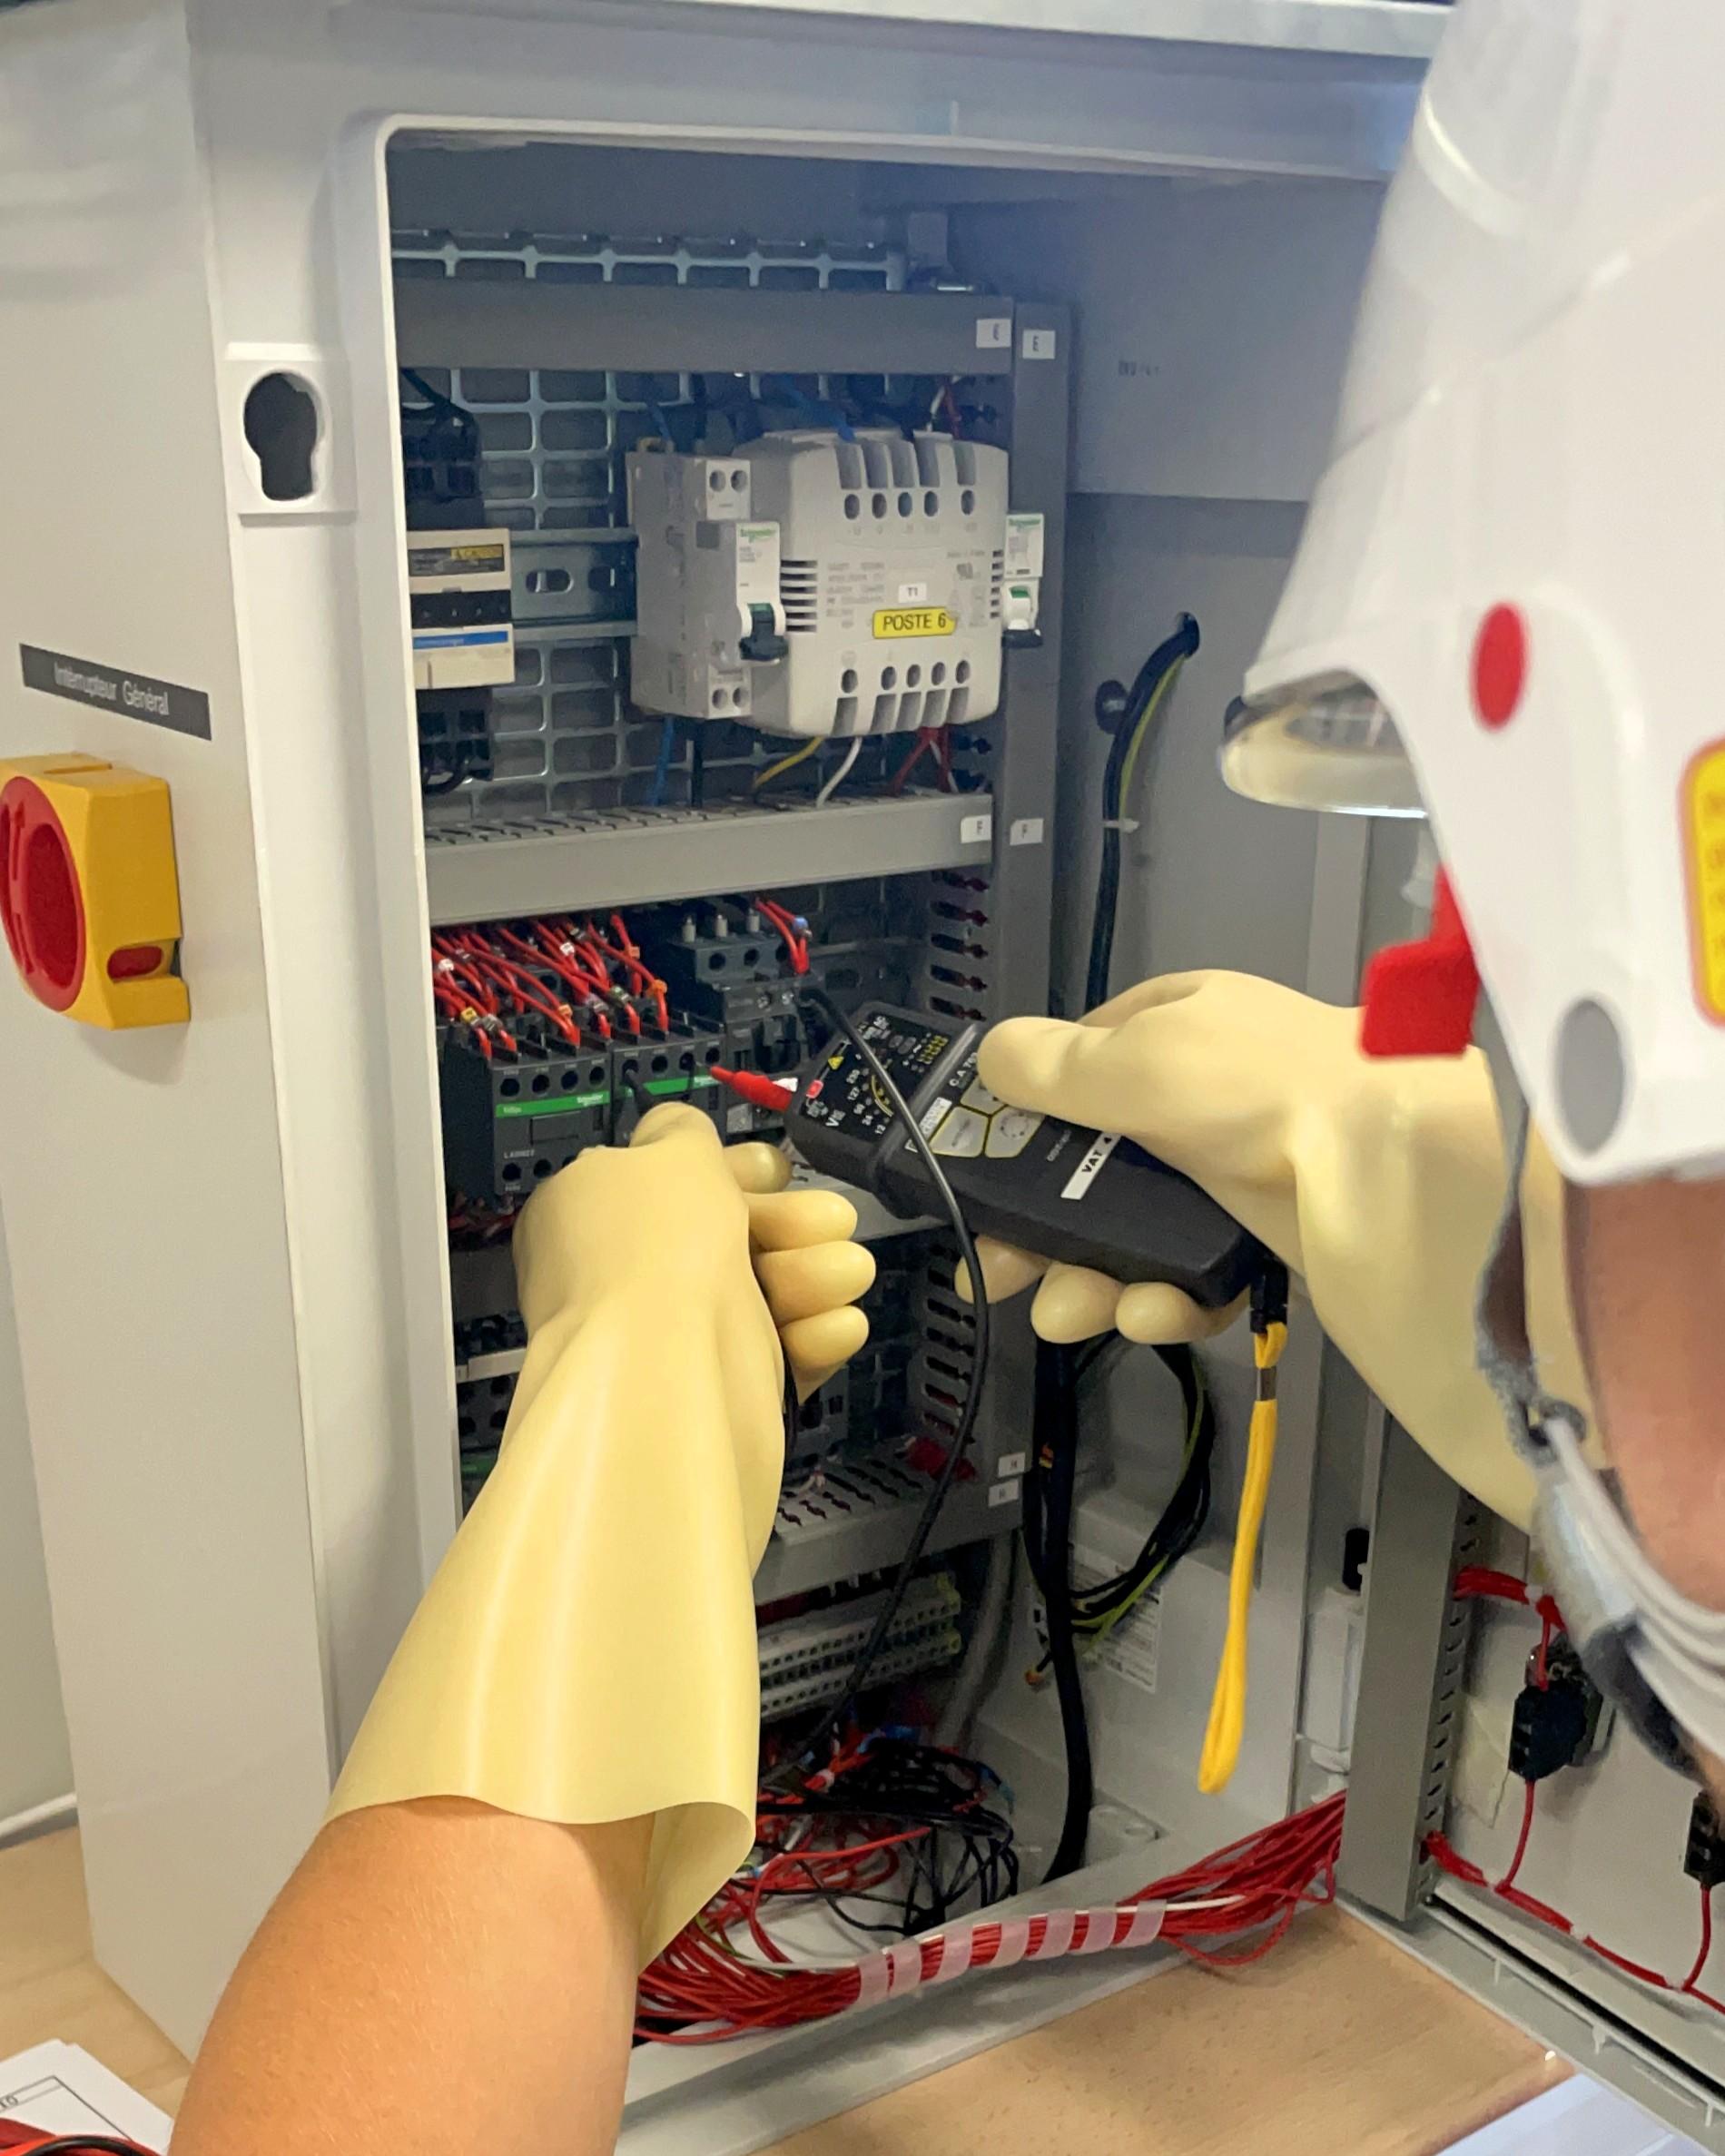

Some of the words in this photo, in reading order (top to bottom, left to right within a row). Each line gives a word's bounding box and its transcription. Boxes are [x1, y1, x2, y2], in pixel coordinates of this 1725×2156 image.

[908, 586, 918, 596] T1
[882, 613, 932, 632] POSTE
[937, 612, 946, 628] 6
[123, 680, 169, 715] Général
[874, 1124, 886, 1135] 12
[1081, 1149, 1103, 1173] VAT
